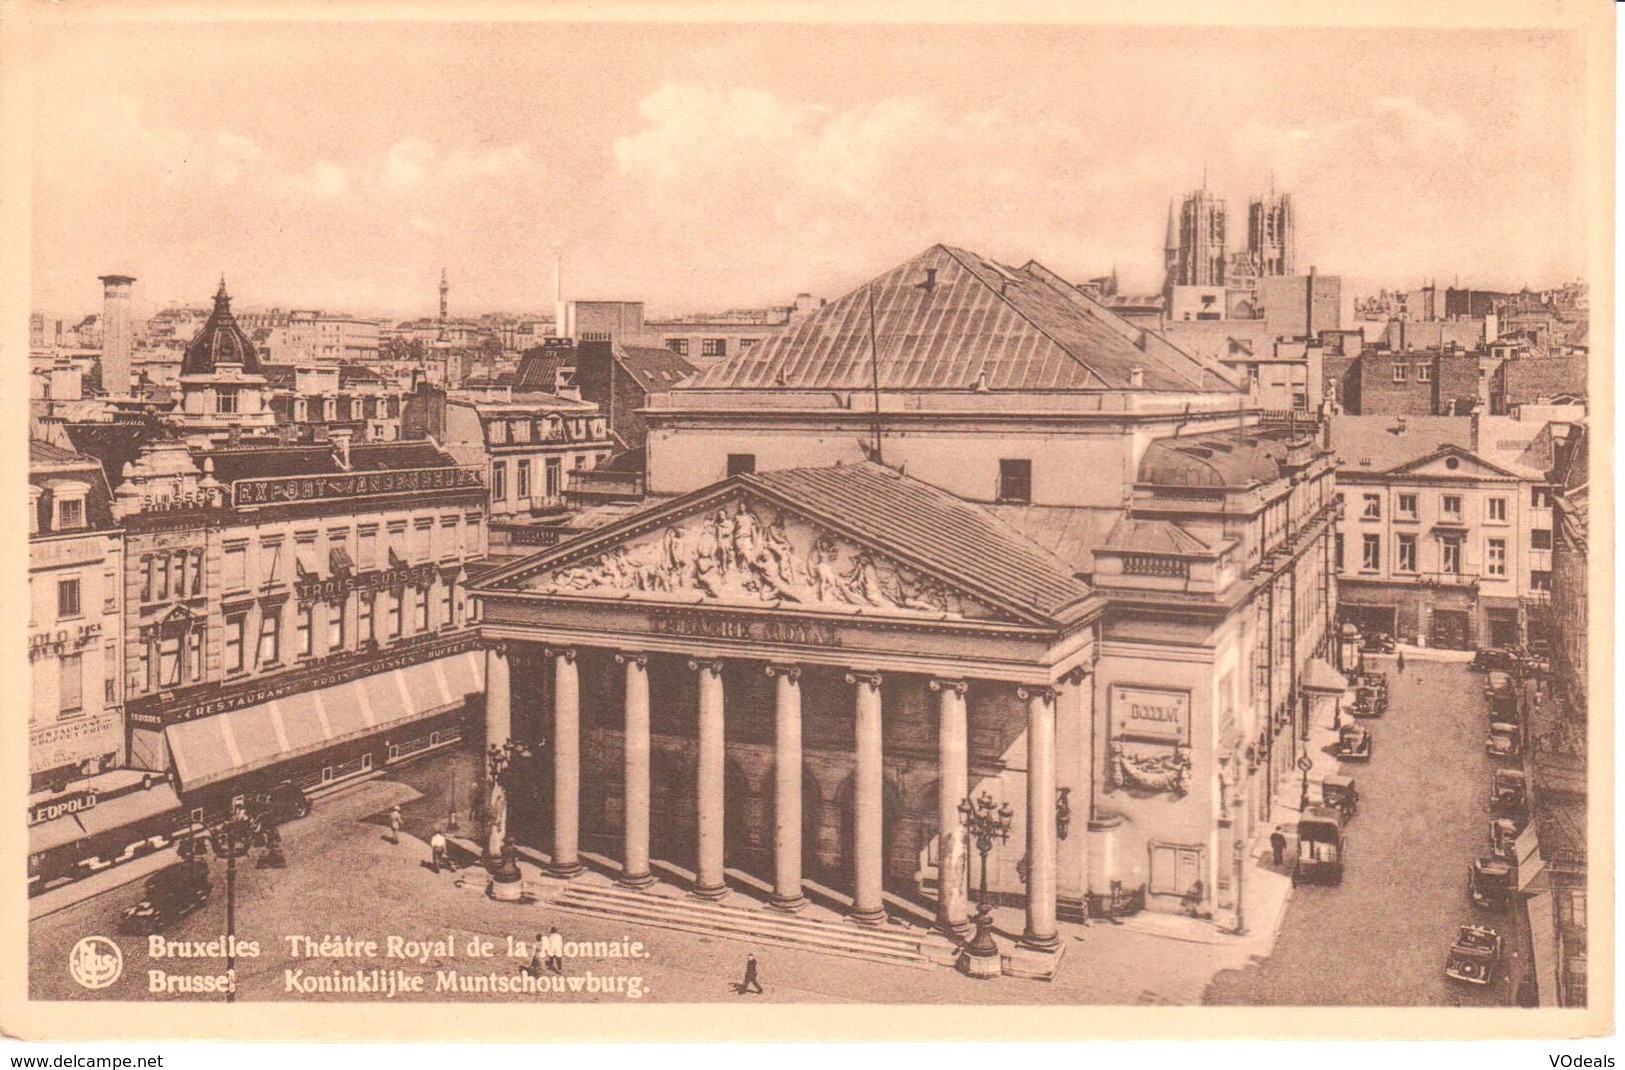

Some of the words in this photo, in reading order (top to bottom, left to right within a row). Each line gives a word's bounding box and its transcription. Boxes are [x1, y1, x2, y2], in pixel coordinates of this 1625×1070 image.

[144, 488, 217, 508] SUISSES
[238, 479, 327, 503] EXPORT
[301, 579, 354, 597] TROIS
[196, 686, 292, 716] RESTAURANT
[312, 673, 350, 687] TROIS
[363, 657, 416, 673] SUISSES
[428, 643, 465, 658] BUFFET
[27, 795, 97, 824] LEOPOLD
